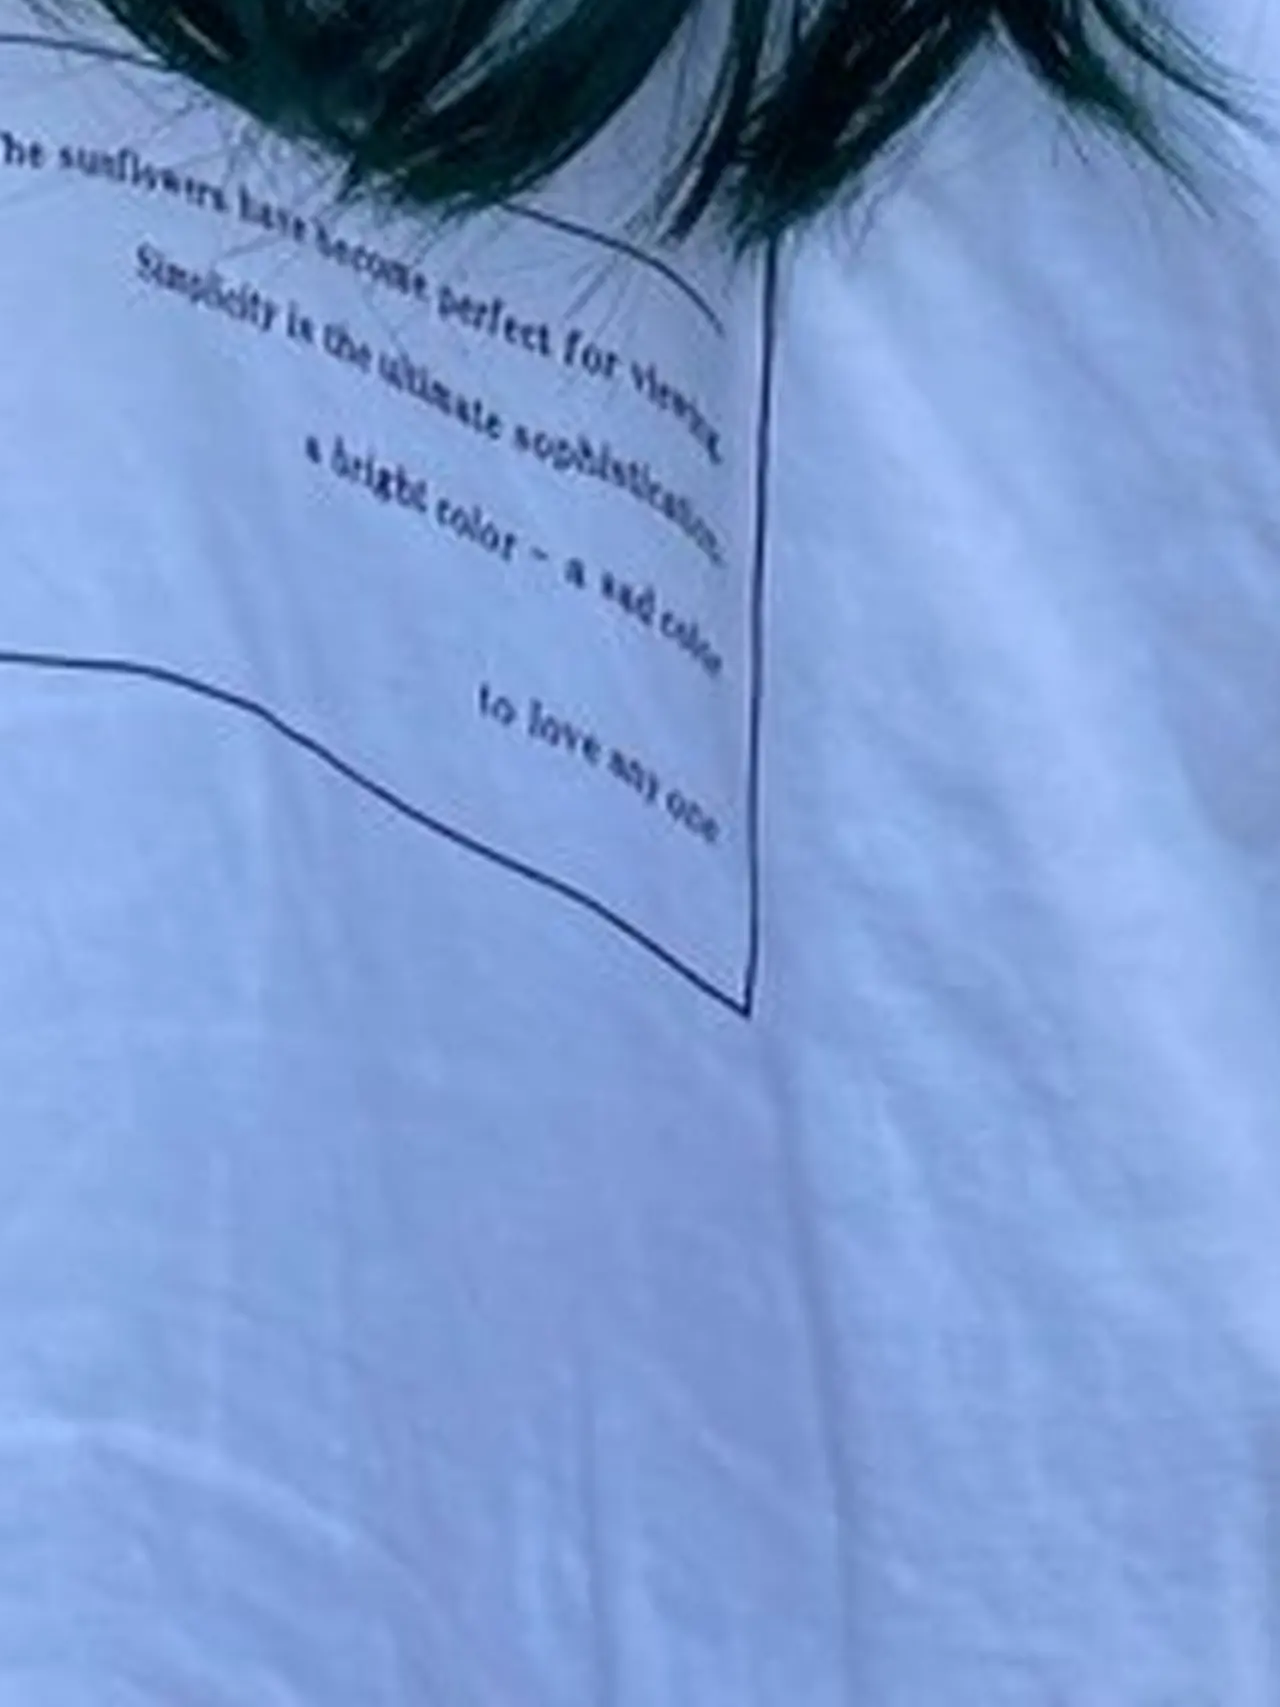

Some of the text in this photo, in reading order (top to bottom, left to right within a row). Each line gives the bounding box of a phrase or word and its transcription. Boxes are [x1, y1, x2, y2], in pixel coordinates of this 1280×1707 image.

[58, 144, 228, 214] sunflowers
[238, 180, 308, 244] have
[308, 214, 428, 302] become
[437, 284, 552, 358] perfect
[563, 328, 625, 379] for
[136, 240, 278, 333] Simplicity
[286, 298, 314, 344] is
[322, 322, 374, 375] the
[378, 350, 504, 441] ultimate
[305, 435, 322, 465] a
[330, 435, 428, 515] bright
[436, 497, 518, 563] color
[565, 557, 586, 589] a
[478, 682, 720, 845] to love any one
